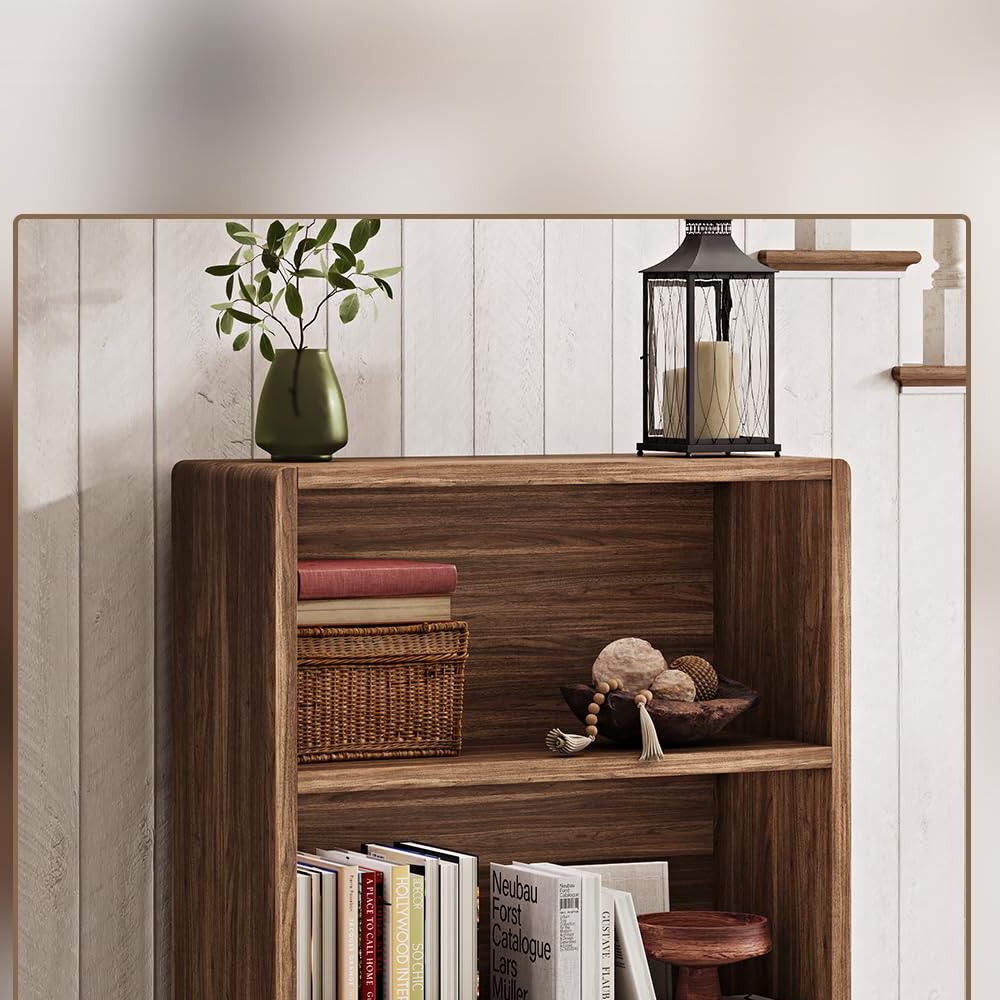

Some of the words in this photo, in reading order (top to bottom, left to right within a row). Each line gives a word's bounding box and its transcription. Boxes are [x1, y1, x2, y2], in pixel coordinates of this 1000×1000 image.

[366, 886, 374, 915] PLACE
[492, 870, 538, 904] Neubau
[366, 917, 374, 930] TO
[396, 877, 409, 965] HOLLYWOOD
[492, 896, 522, 927] Forst
[366, 932, 374, 955] CALL
[492, 922, 552, 963] Catalogue
[601, 911, 611, 959] GUSTAVE
[412, 943, 424, 961] SO
[492, 949, 518, 978] Lars
[366, 961, 374, 986] HOME
[412, 962, 424, 991] CHIC
